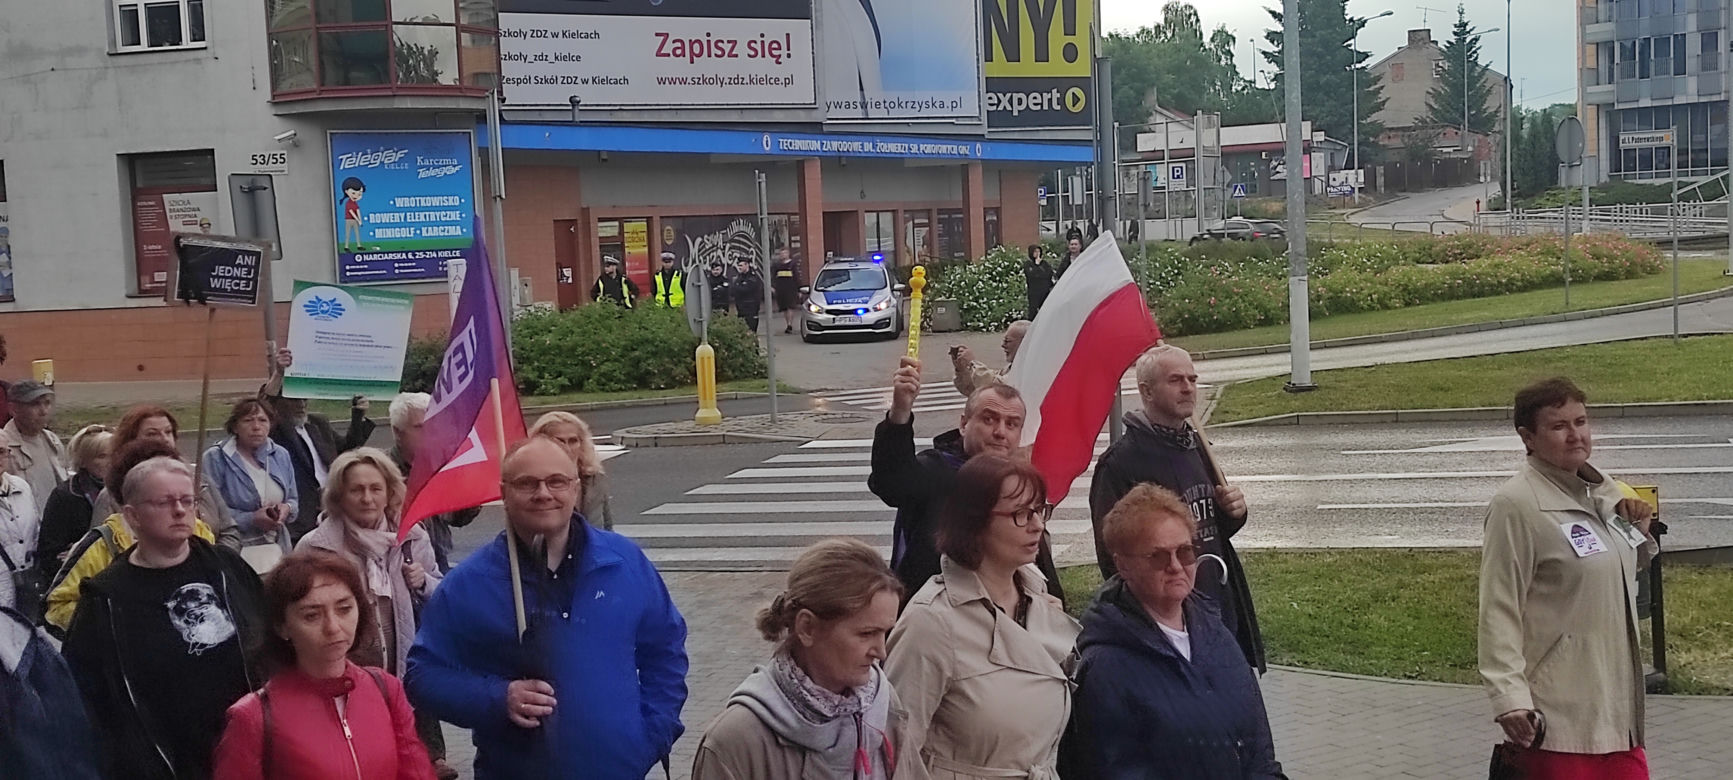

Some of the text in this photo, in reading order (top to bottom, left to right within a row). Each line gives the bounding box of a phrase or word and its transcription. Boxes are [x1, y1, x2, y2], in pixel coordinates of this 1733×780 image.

[529, 29, 549, 38] ZDZ
[561, 29, 600, 39] Kielcach
[985, 0, 1079, 64] NY!
[654, 32, 792, 65] Zapisz się!
[501, 75, 532, 86] Zespół
[533, 75, 558, 85] Szkół
[560, 76, 579, 85] ZDZ
[591, 76, 629, 85] Kielcach
[656, 74, 794, 87] www.szkoly.zdz.kielce.pl
[986, 88, 1061, 116] expert
[778, 138, 821, 151] TECHNIKUM
[822, 140, 863, 152] ZAWODOWE
[251, 153, 286, 166] 53/55
[339, 149, 408, 170] Telegraf
[417, 156, 457, 165] Karczma
[395, 196, 460, 208] WROTKOWISKO
[369, 211, 461, 223] ROWERY ELEKTRYCZNE
[375, 226, 462, 238] MINIGOLF KARCZMA
[235, 255, 256, 266] ANI
[363, 253, 407, 261] NARCIARSKA
[437, 250, 461, 258] KIELCE
[211, 266, 255, 278] JEDNEJ
[209, 278, 253, 292] WIĘCEJ
